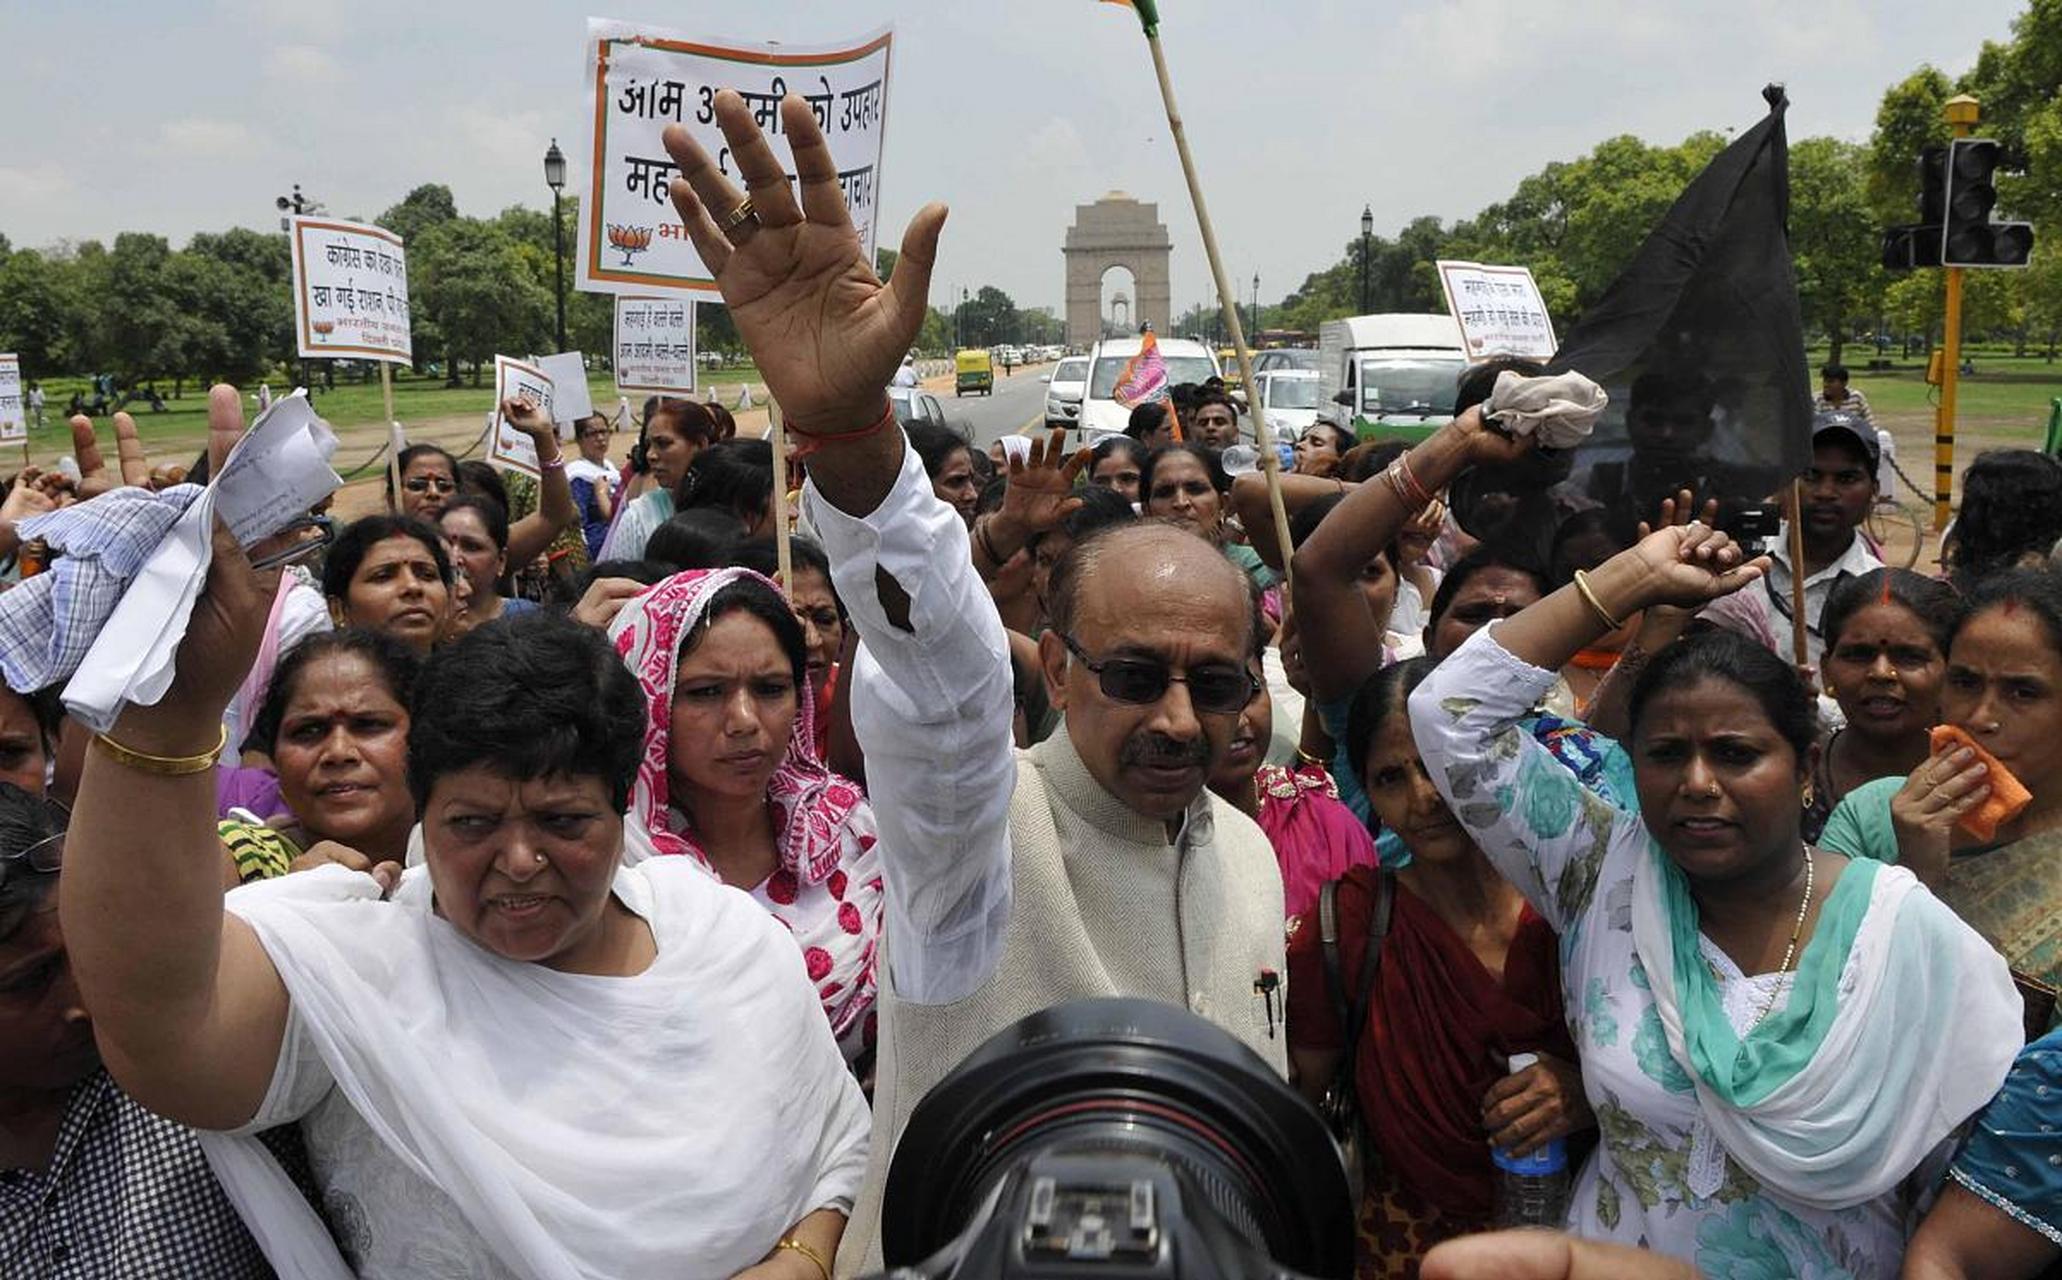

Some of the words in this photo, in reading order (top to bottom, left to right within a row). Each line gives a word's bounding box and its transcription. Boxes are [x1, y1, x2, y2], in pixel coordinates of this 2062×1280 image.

[841, 78, 882, 132] उपहार
[326, 237, 362, 269] कांग्रेस
[312, 286, 332, 308] खा
[336, 277, 355, 314] गई
[357, 288, 384, 315] राशन
